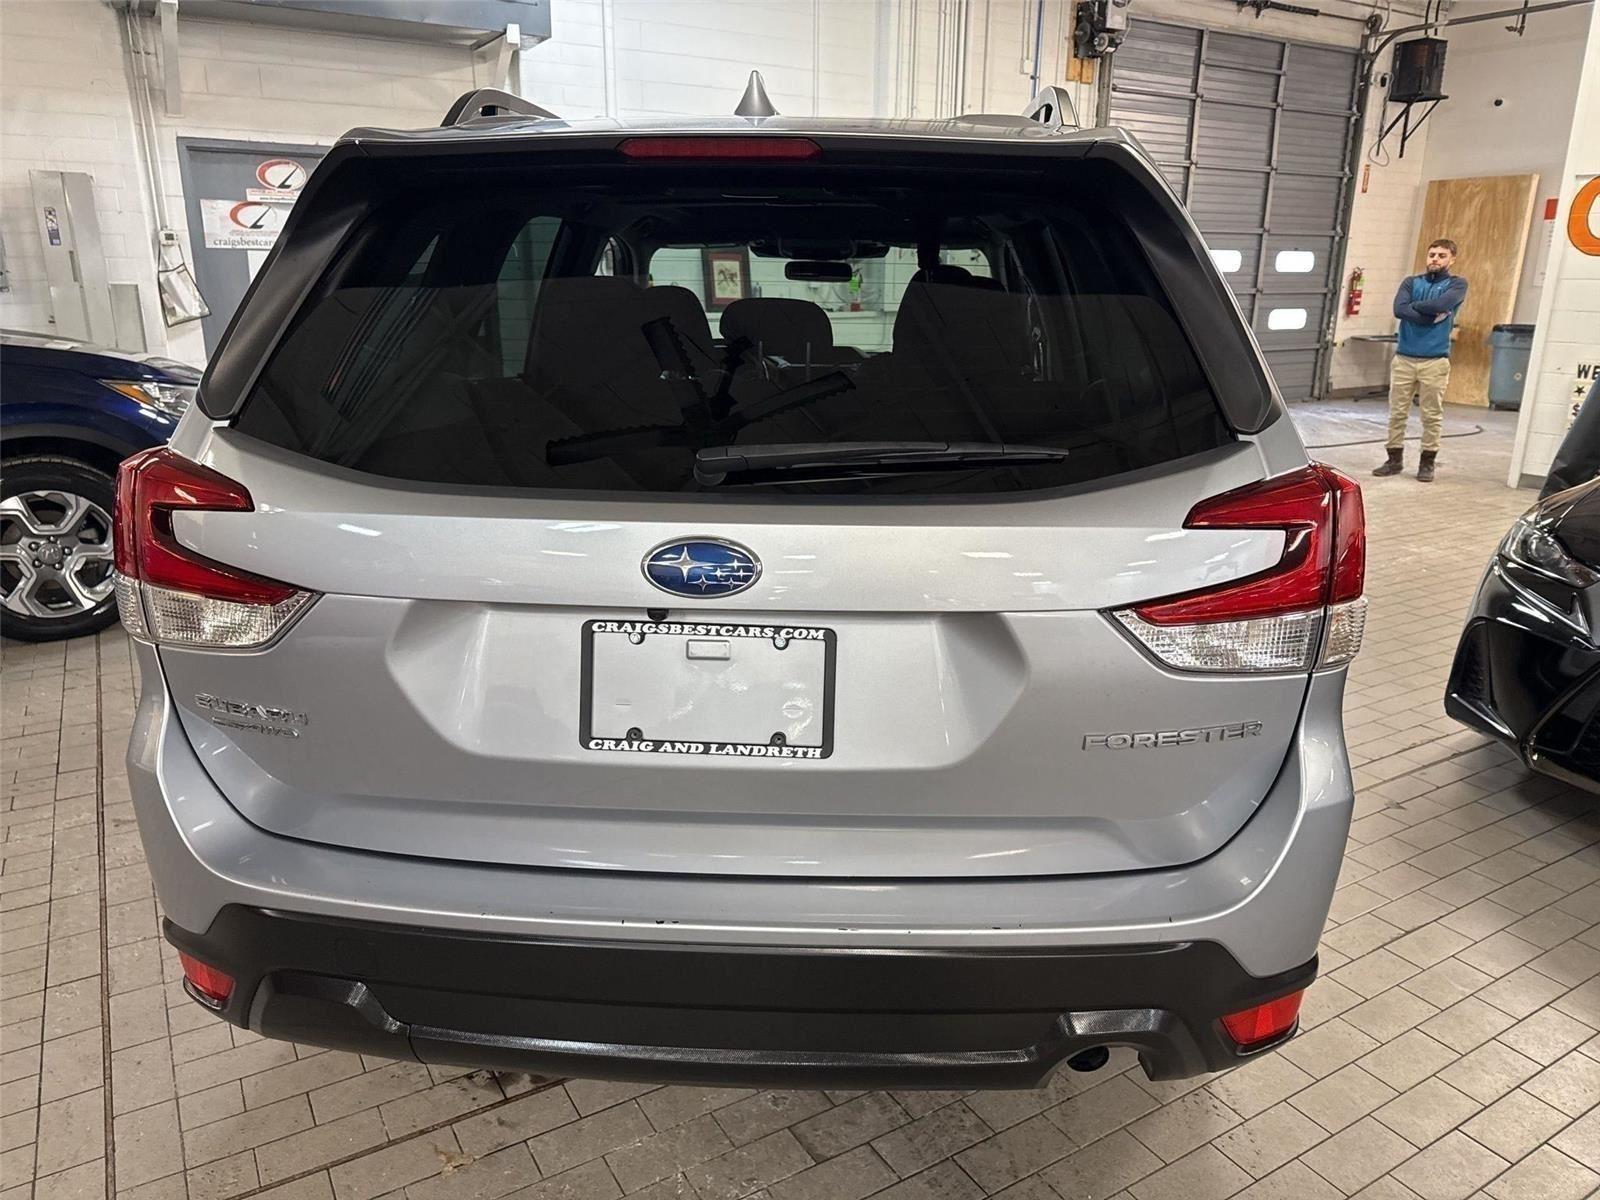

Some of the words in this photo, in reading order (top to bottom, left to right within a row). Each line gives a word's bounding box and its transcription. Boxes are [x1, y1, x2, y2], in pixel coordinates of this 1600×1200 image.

[592, 622, 826, 640] CRAIGSBESTCARS.COM
[1082, 720, 1263, 750] FORESTER
[588, 739, 654, 752] CRAIG
[658, 742, 704, 754] AND
[709, 744, 823, 758] LANDRETH
